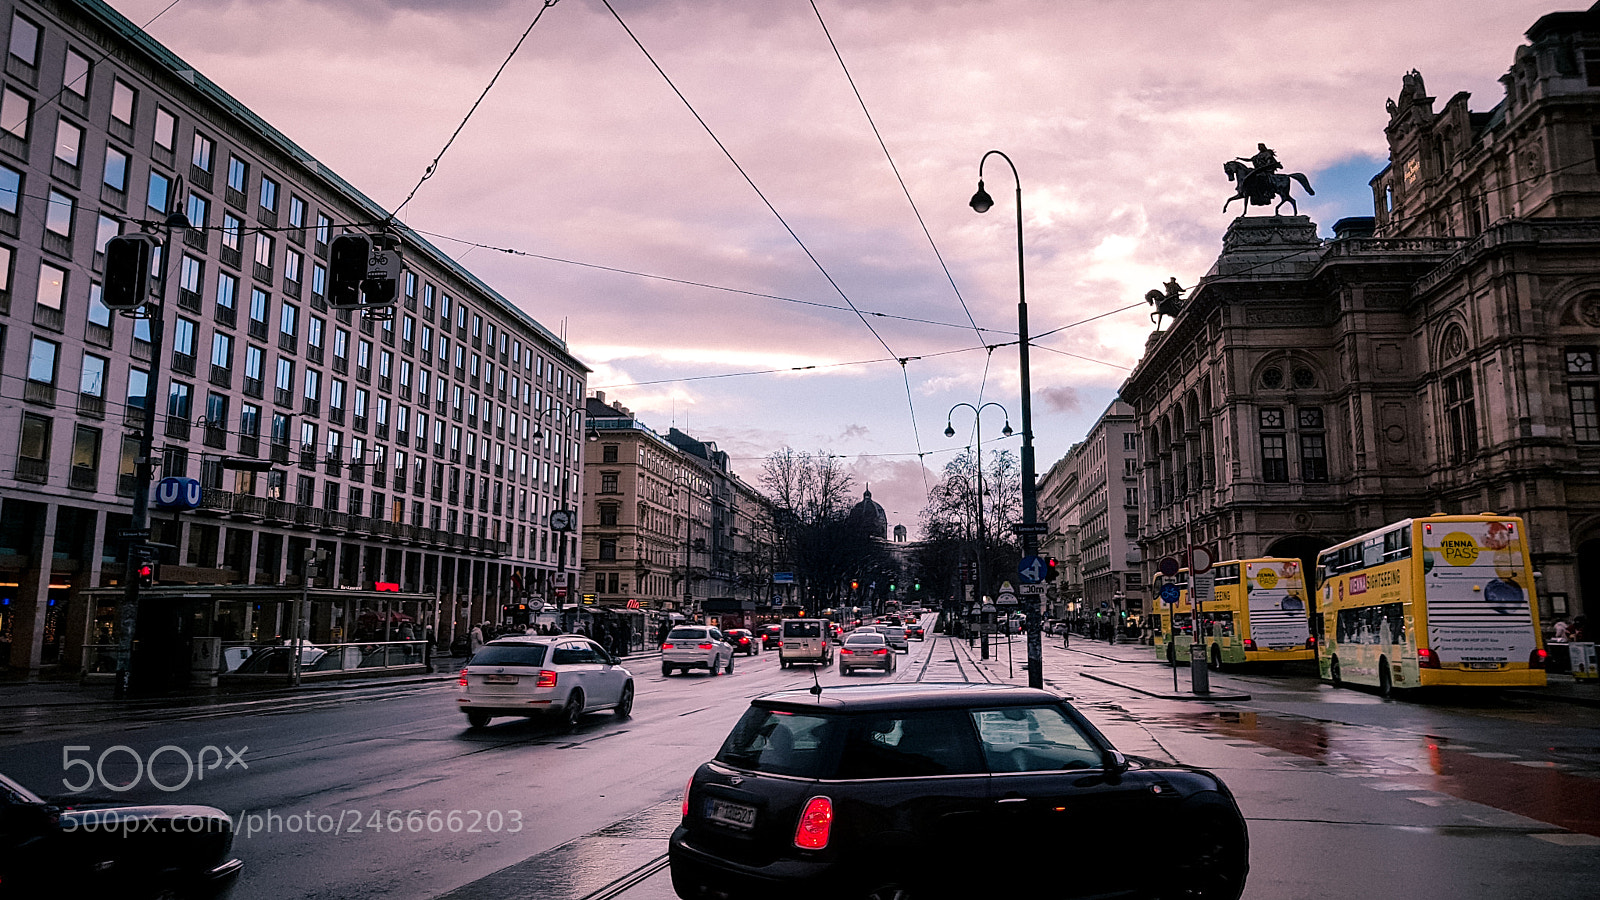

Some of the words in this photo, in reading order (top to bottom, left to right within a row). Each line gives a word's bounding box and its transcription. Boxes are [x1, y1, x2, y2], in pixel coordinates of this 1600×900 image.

[160, 482, 179, 504] U
[186, 482, 200, 505] U
[1440, 540, 1473, 548] VIENNA
[1446, 547, 1479, 559] PASS
[1366, 568, 1401, 590] SIGHTSEEING
